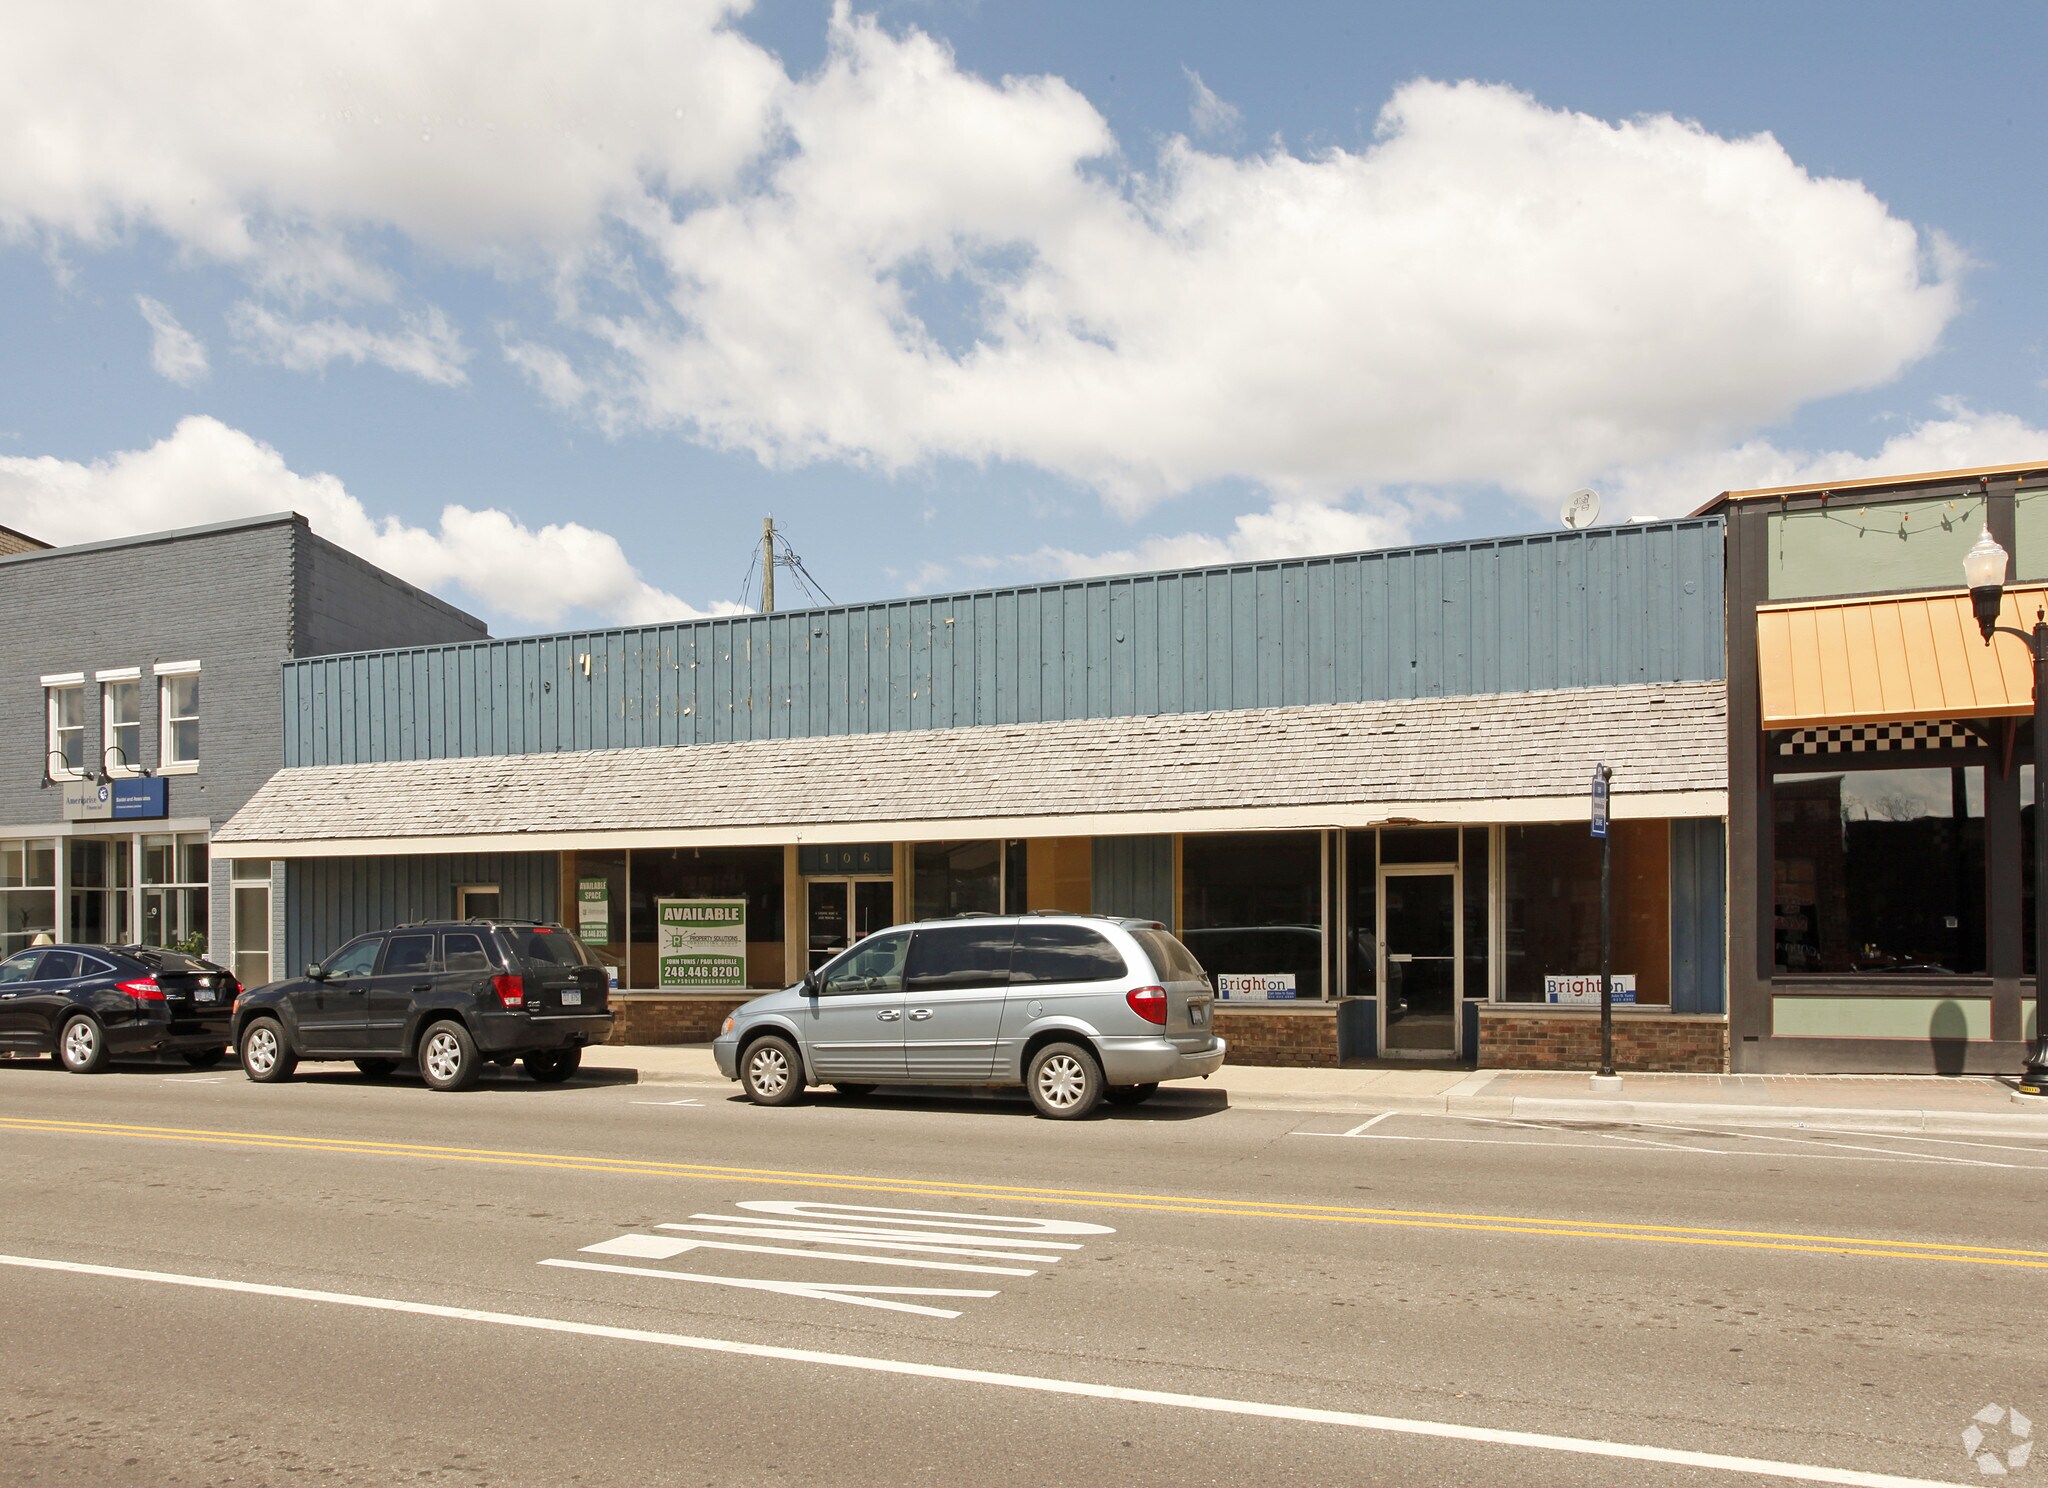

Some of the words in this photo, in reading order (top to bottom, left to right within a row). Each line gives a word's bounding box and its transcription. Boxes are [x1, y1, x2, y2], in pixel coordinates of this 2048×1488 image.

[824, 852, 870, 864] 106
[579, 881, 607, 890] AVAILABLE
[584, 891, 602, 900] SPACE
[663, 907, 739, 921] AVAILABLE
[664, 966, 740, 977] 248.446.8200
[1219, 976, 1286, 994] Brighton
[1547, 978, 1624, 997] Brightn
